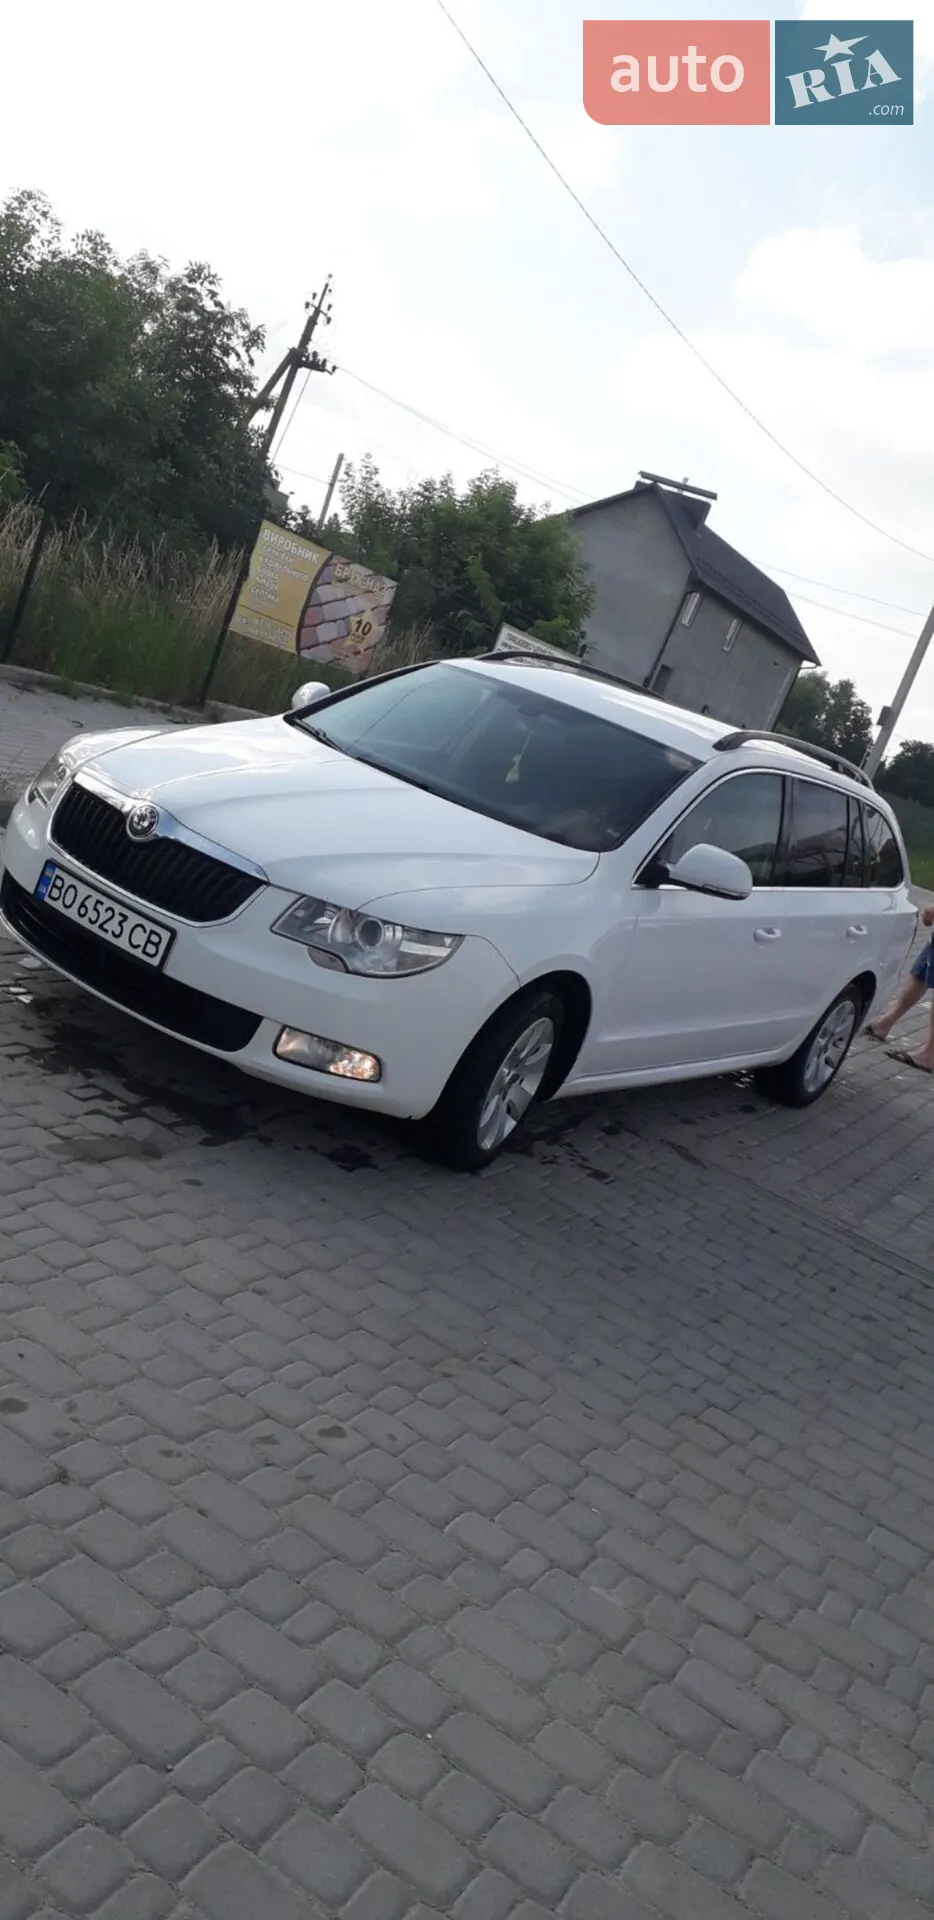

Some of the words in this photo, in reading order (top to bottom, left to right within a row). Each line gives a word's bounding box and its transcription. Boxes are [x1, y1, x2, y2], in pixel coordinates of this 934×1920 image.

[263, 529, 320, 563] ВИРОБНИК
[354, 618, 373, 637] 10
[48, 874, 78, 909] BO
[77, 894, 129, 939] 6523
[128, 923, 162, 958] CB
